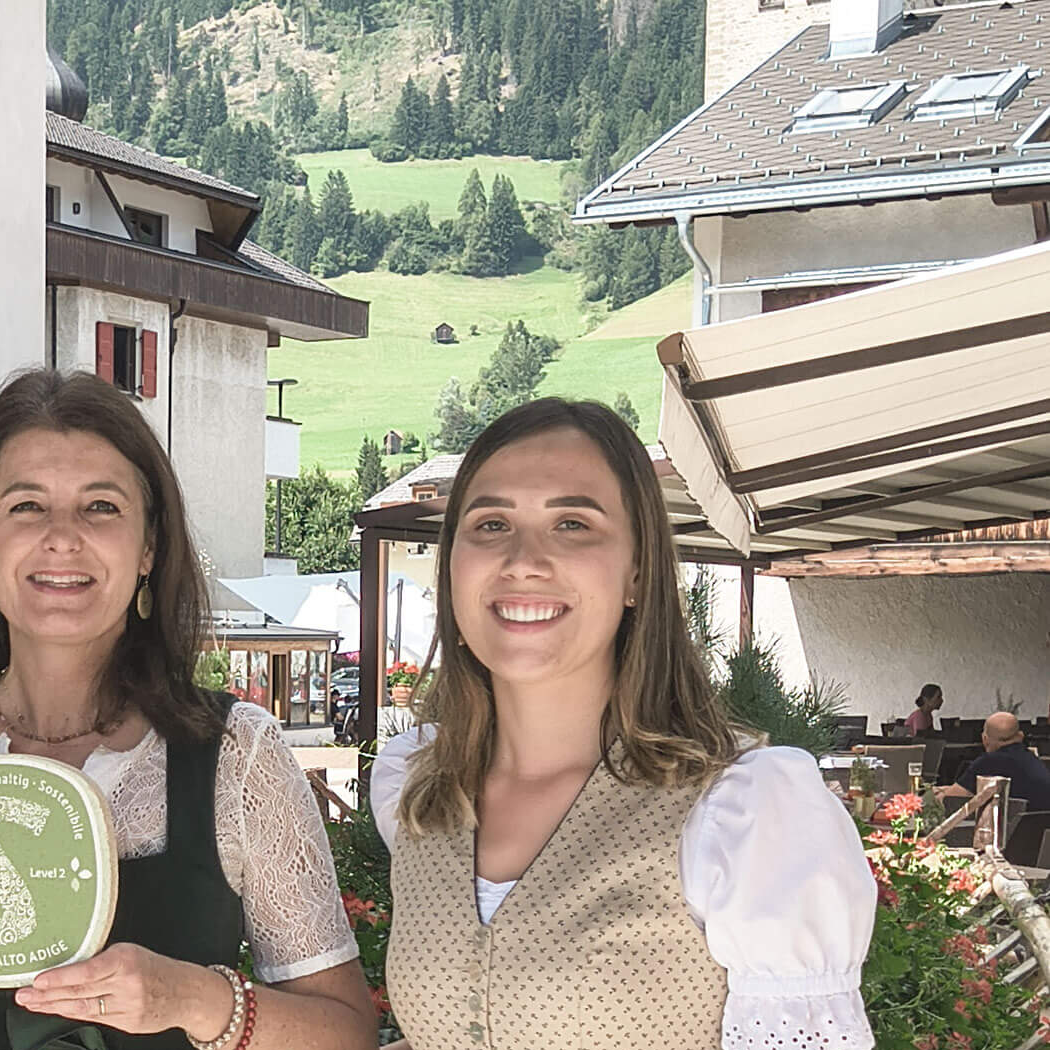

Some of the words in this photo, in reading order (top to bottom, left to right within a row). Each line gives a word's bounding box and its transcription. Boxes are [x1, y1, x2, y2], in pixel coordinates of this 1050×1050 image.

[38, 780, 84, 841] Sostenible
[30, 867, 58, 879] Level
[58, 868, 67, 879] 2
[29, 940, 69, 963] ADIGE
